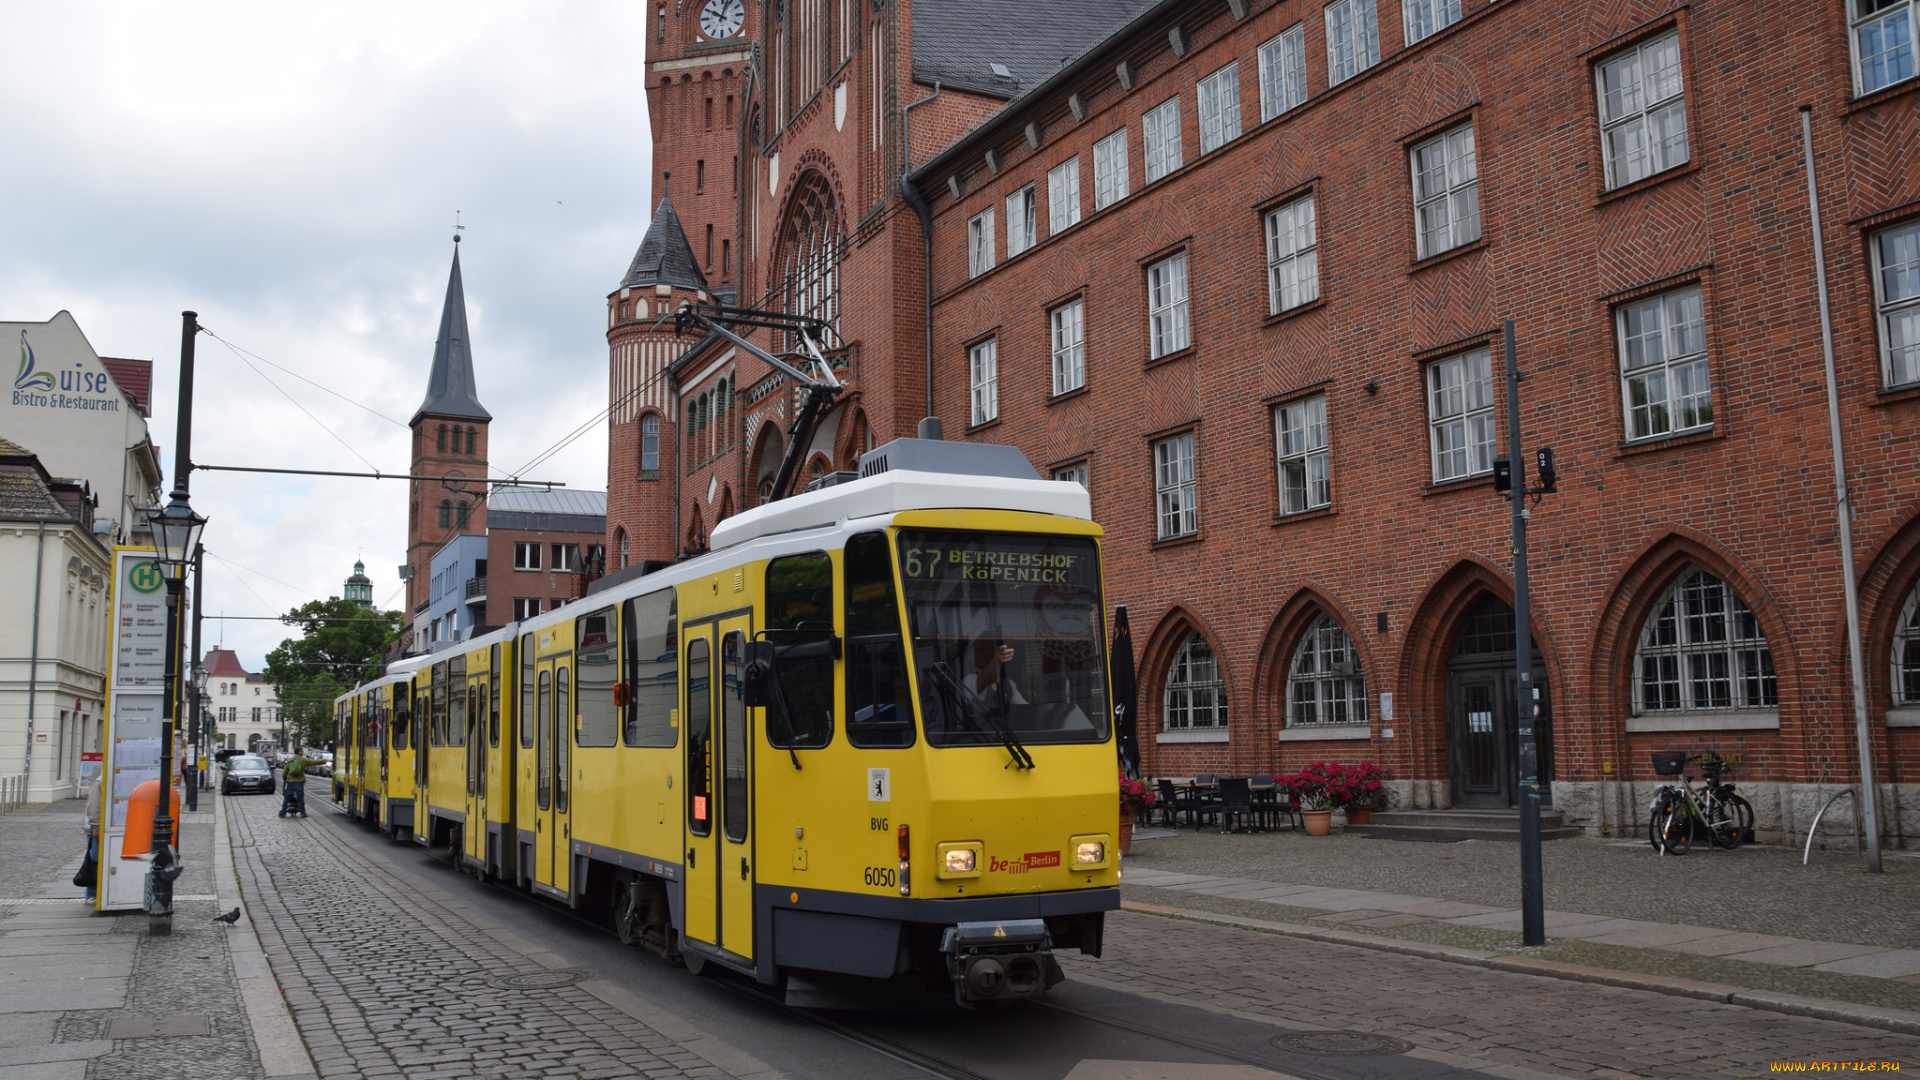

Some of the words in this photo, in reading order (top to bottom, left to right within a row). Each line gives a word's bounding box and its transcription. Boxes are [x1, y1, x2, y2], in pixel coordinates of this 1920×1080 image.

[12, 390, 48, 407] Bistro
[50, 393, 58, 408] &
[59, 394, 119, 412] Restaurant
[905, 547, 942, 578] 67
[949, 550, 1078, 568] BETRIEBSHOF
[870, 817, 889, 832] BVG
[989, 855, 1008, 873] be
[1030, 855, 1057, 866] Berlin
[864, 866, 896, 888] 6050
